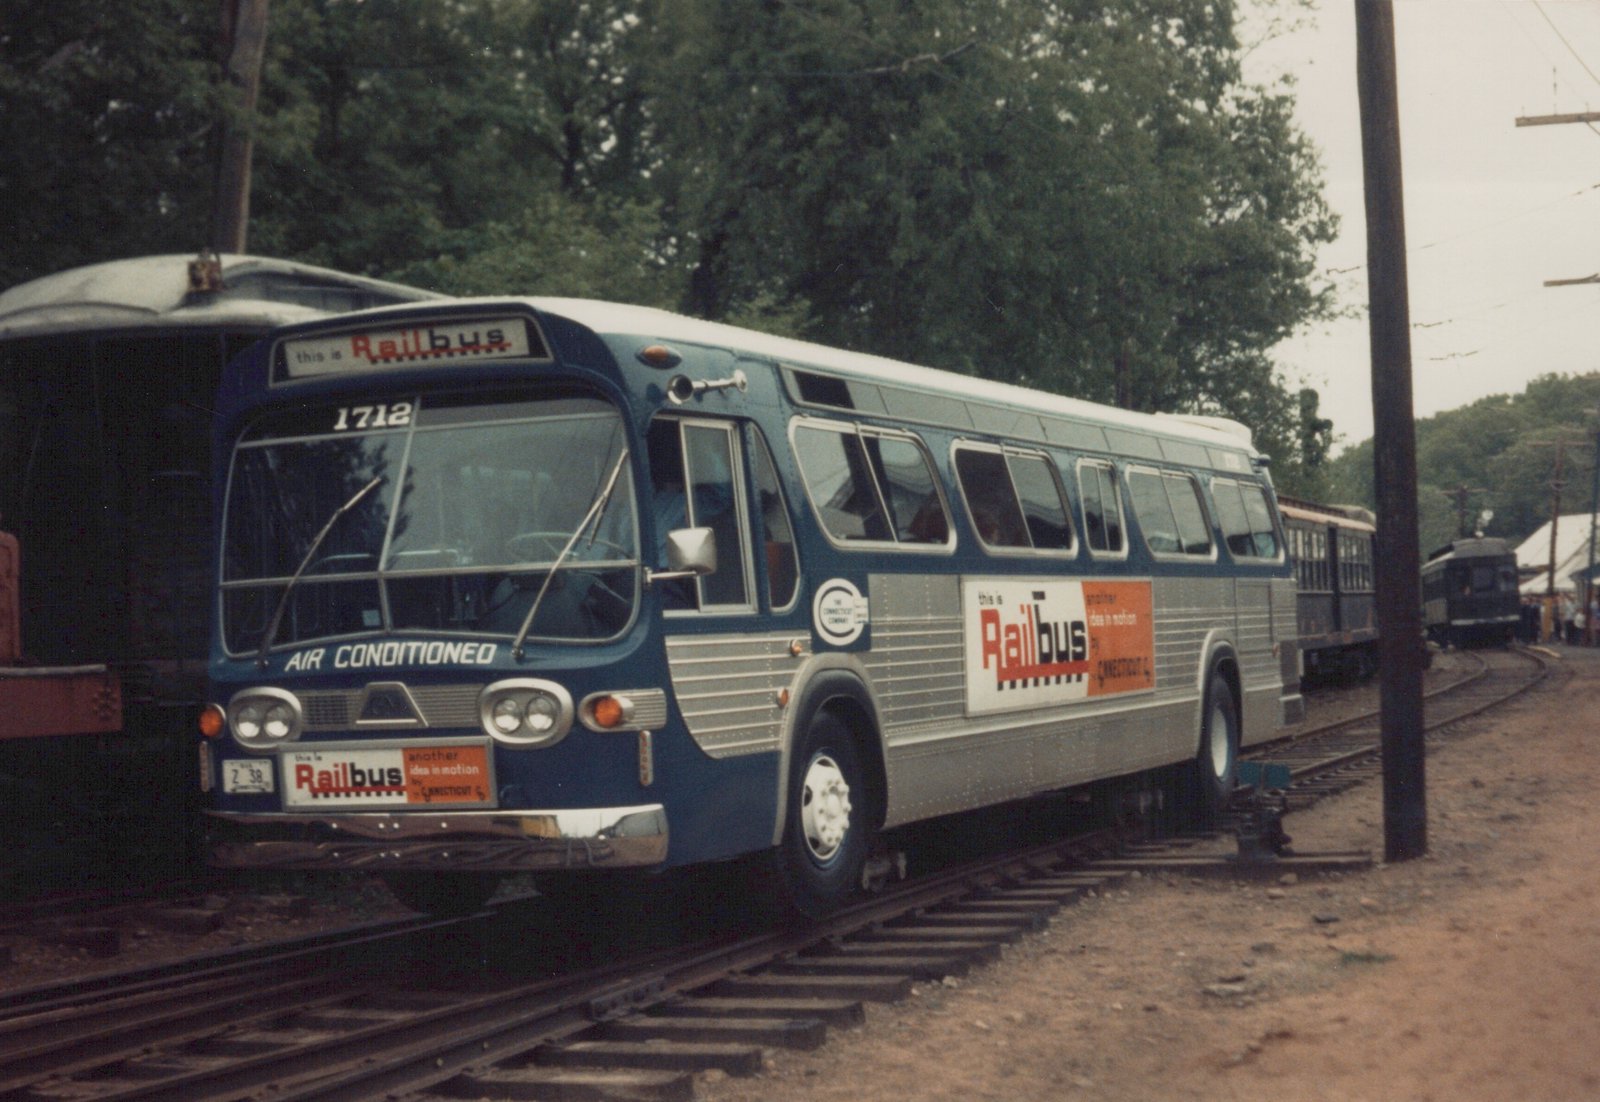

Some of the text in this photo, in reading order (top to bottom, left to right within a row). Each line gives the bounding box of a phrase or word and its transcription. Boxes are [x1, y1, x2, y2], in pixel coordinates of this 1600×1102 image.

[296, 328, 507, 365] this is Railbus
[333, 402, 412, 431] 1712
[980, 603, 1087, 678] Railbus
[284, 641, 498, 673] AIR CONDITIONED
[408, 750, 459, 762] another
[294, 762, 402, 794] Railbus
